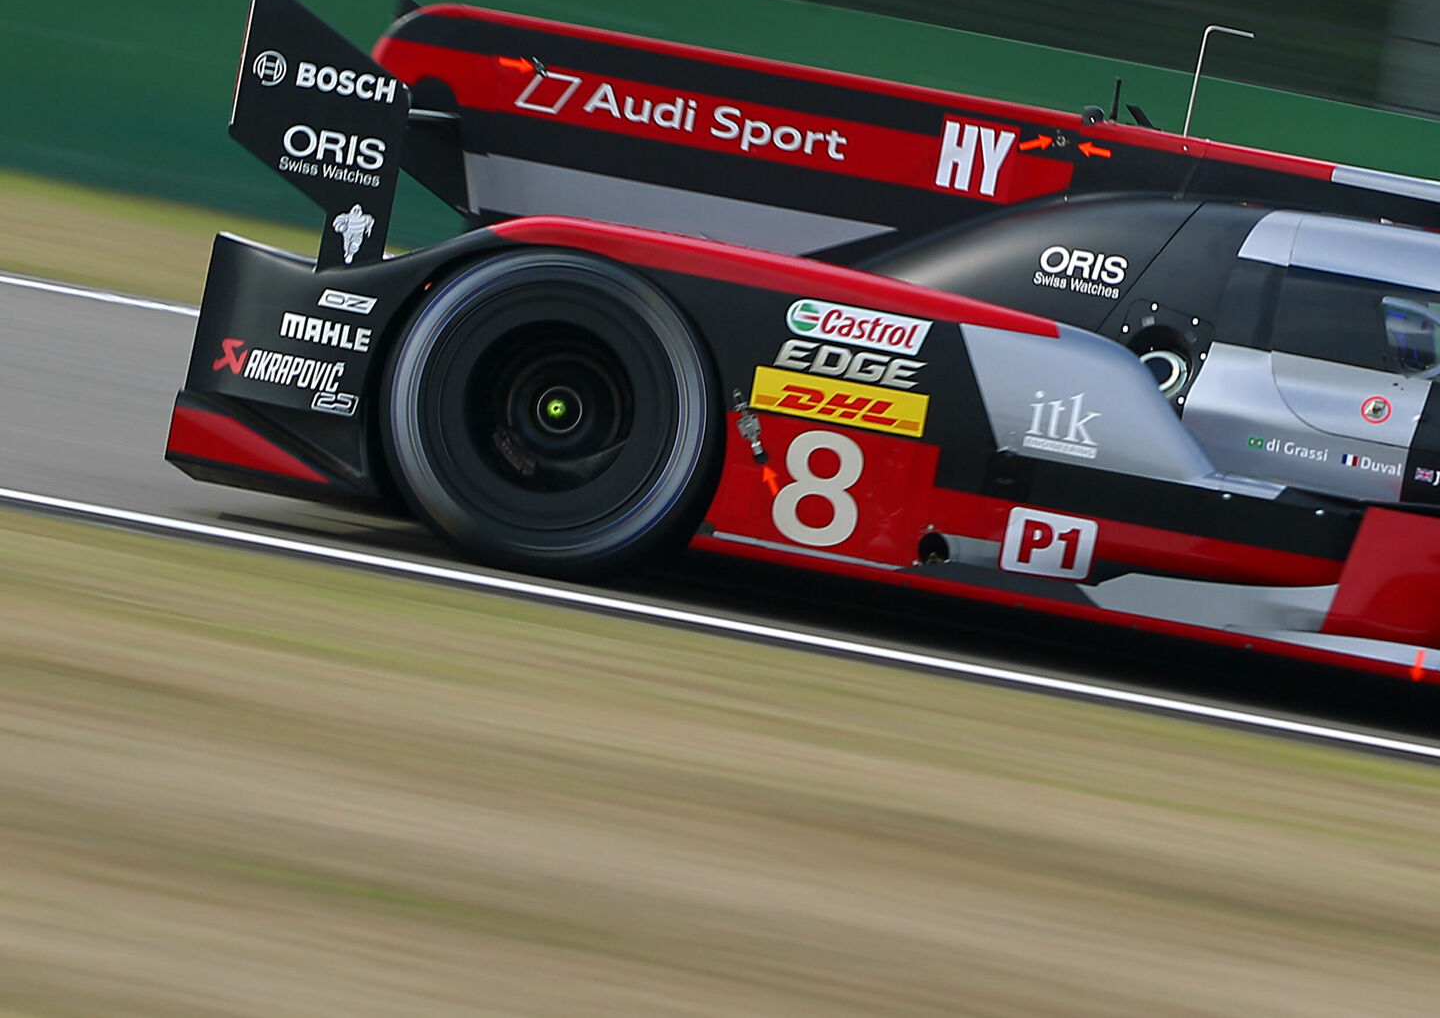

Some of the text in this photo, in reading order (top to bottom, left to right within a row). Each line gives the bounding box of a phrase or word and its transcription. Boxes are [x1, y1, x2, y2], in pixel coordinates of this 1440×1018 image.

[296, 62, 397, 104] BOSCH
[583, 83, 847, 161] Audi Sport
[283, 124, 386, 170] ORIS
[935, 121, 1016, 196] HY
[279, 155, 381, 188] Swiss Watches
[1033, 271, 1120, 300] Swiss Watches
[1040, 246, 1128, 285] ORIS
[325, 293, 369, 311] OZ
[280, 312, 373, 352] MAHLE
[820, 308, 920, 350] Castrol
[773, 338, 928, 389] EDGE
[775, 384, 900, 428] DHL
[1024, 390, 1102, 447] itk
[1266, 438, 1329, 462] di Grassi
[1360, 456, 1402, 476] Duval
[771, 430, 864, 546] 8
[1016, 519, 1080, 570] P1
